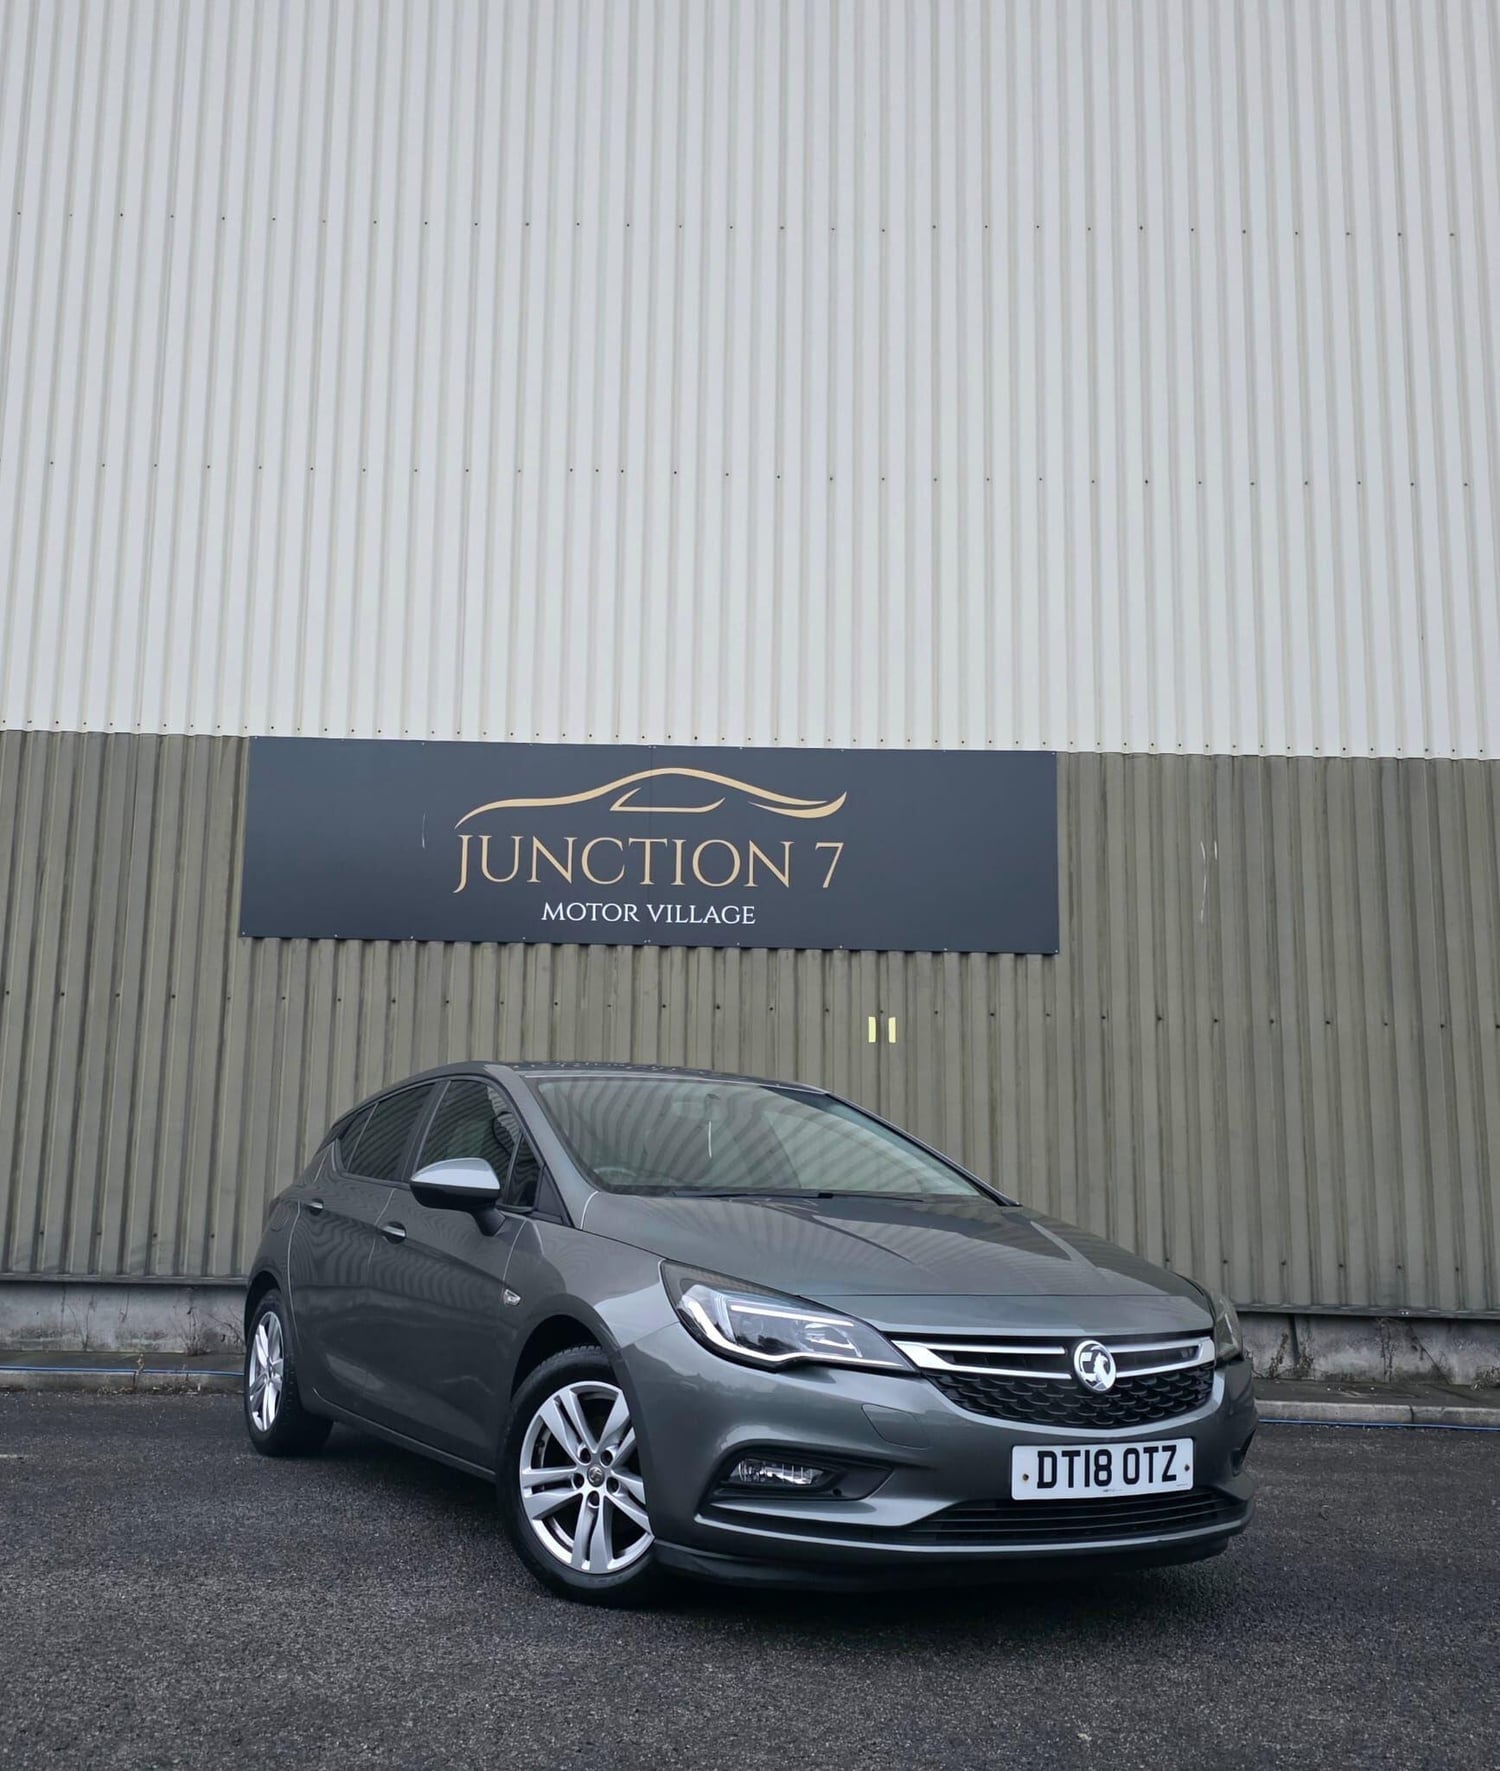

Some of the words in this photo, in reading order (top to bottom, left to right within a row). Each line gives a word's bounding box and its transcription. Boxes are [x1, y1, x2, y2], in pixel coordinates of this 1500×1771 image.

[453, 834, 795, 894] JUNCTION
[815, 841, 845, 889] 7
[541, 901, 641, 922] MOTOR
[645, 903, 756, 925] VILLAGE
[1037, 1448, 1113, 1489] DT18
[1122, 1445, 1177, 1486] OTZ
